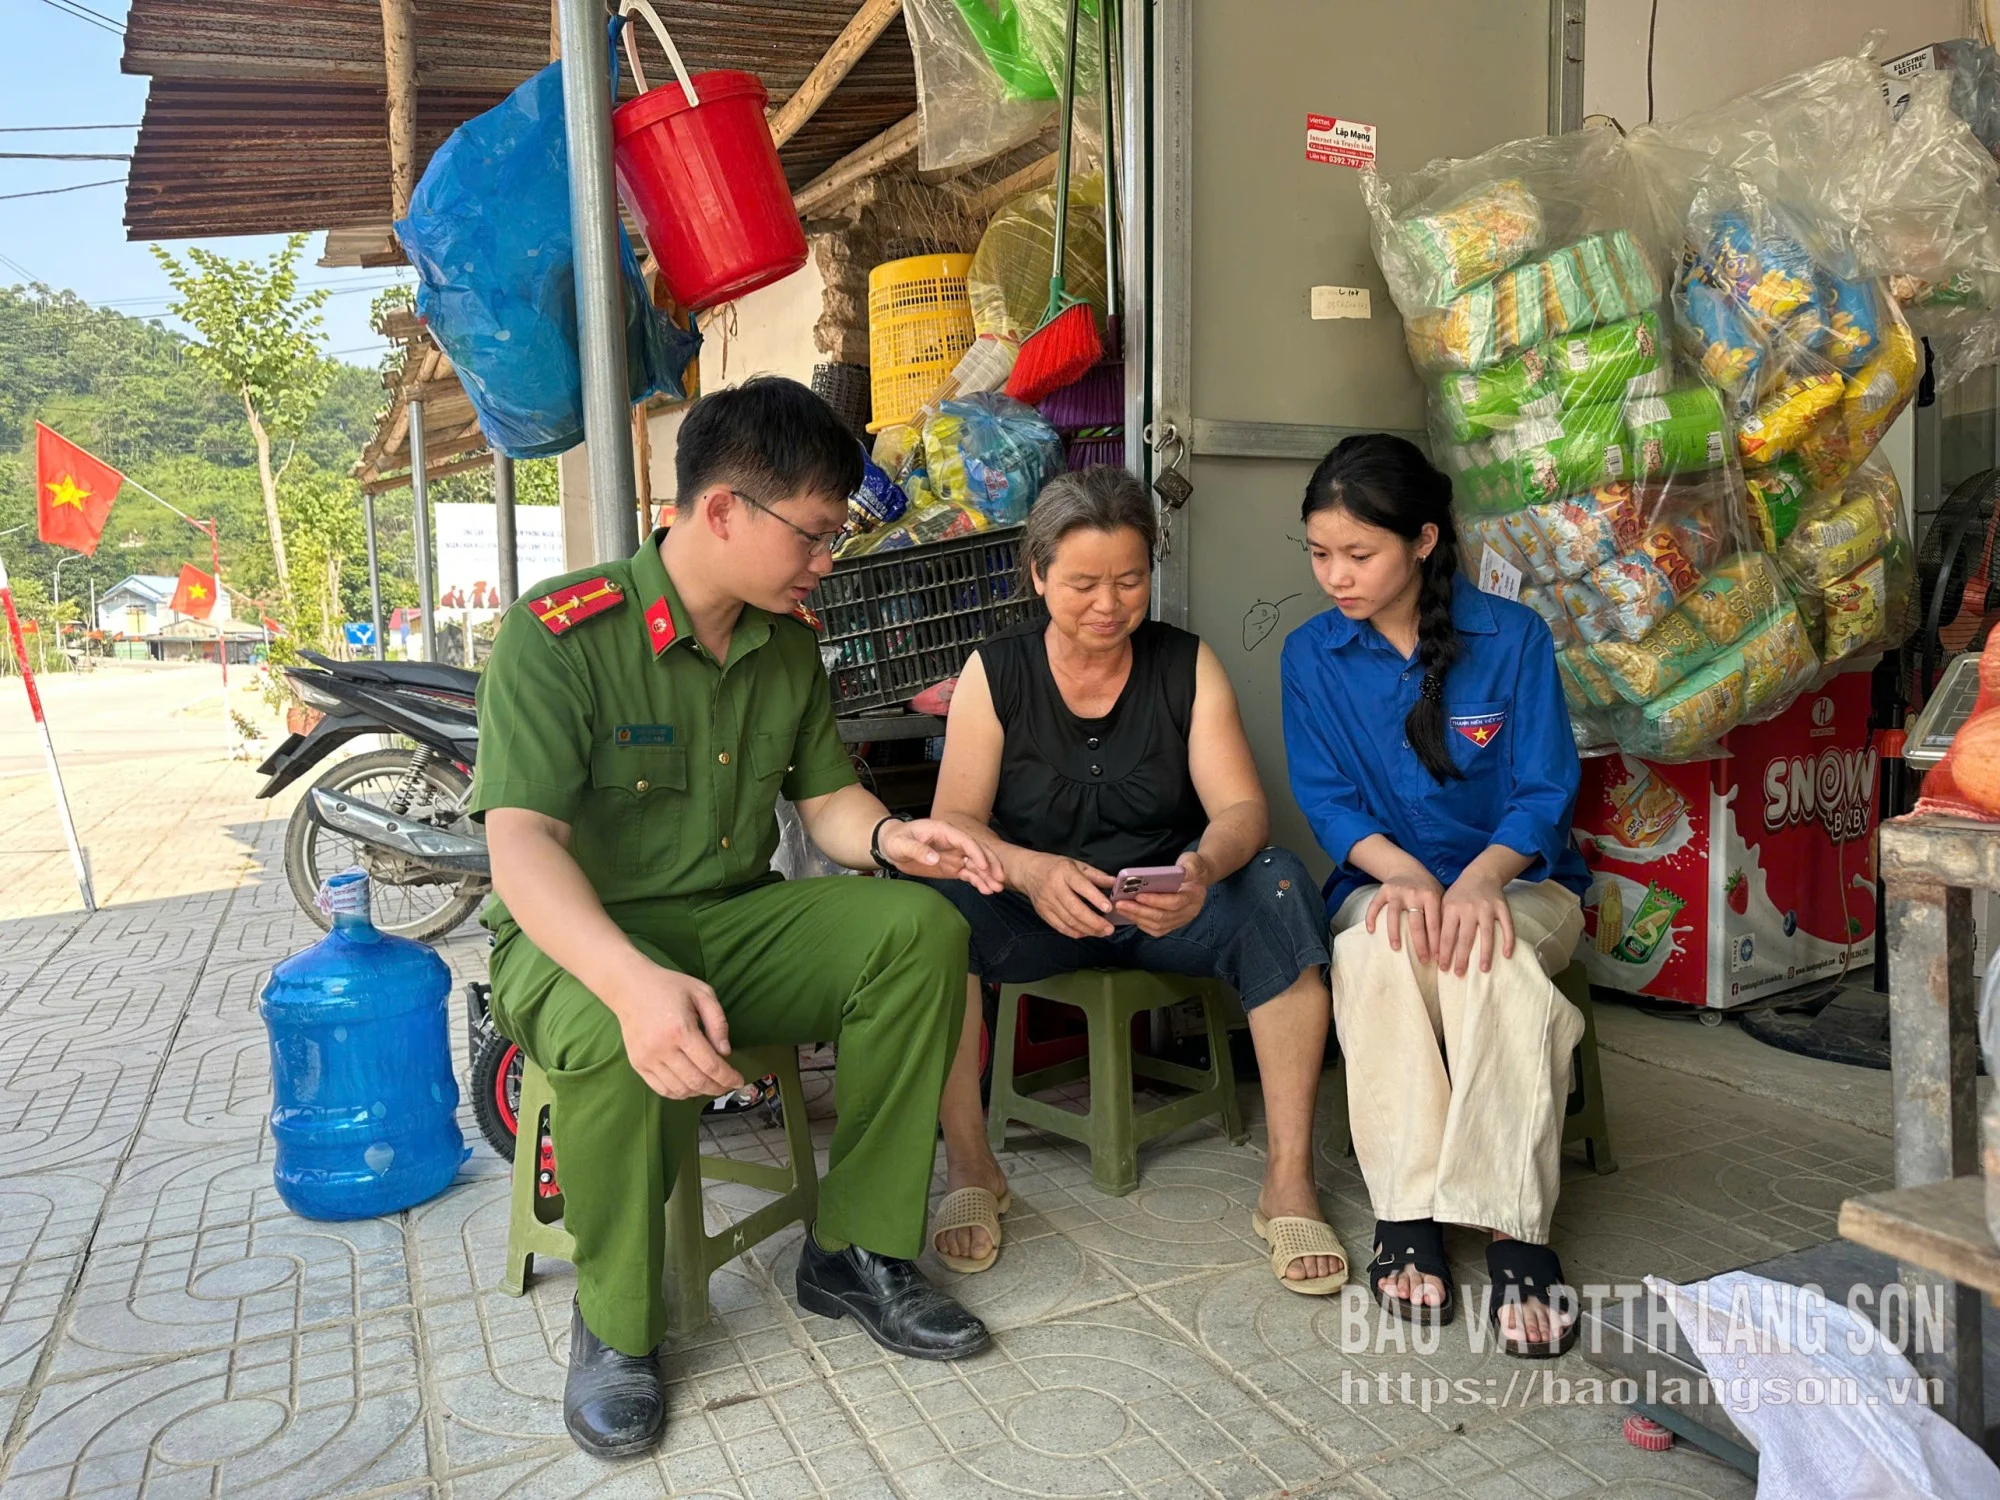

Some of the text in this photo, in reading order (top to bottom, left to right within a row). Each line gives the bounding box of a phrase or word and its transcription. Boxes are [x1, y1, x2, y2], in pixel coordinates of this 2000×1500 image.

[1893, 53, 1927, 71] ELECTRIC
[1898, 61, 1923, 76] KETTLE
[1309, 134, 1332, 143] Internet
[1350, 129, 1371, 142] Mạng
[1765, 748, 1877, 823] SNOW
[1833, 806, 1870, 833] BABY
